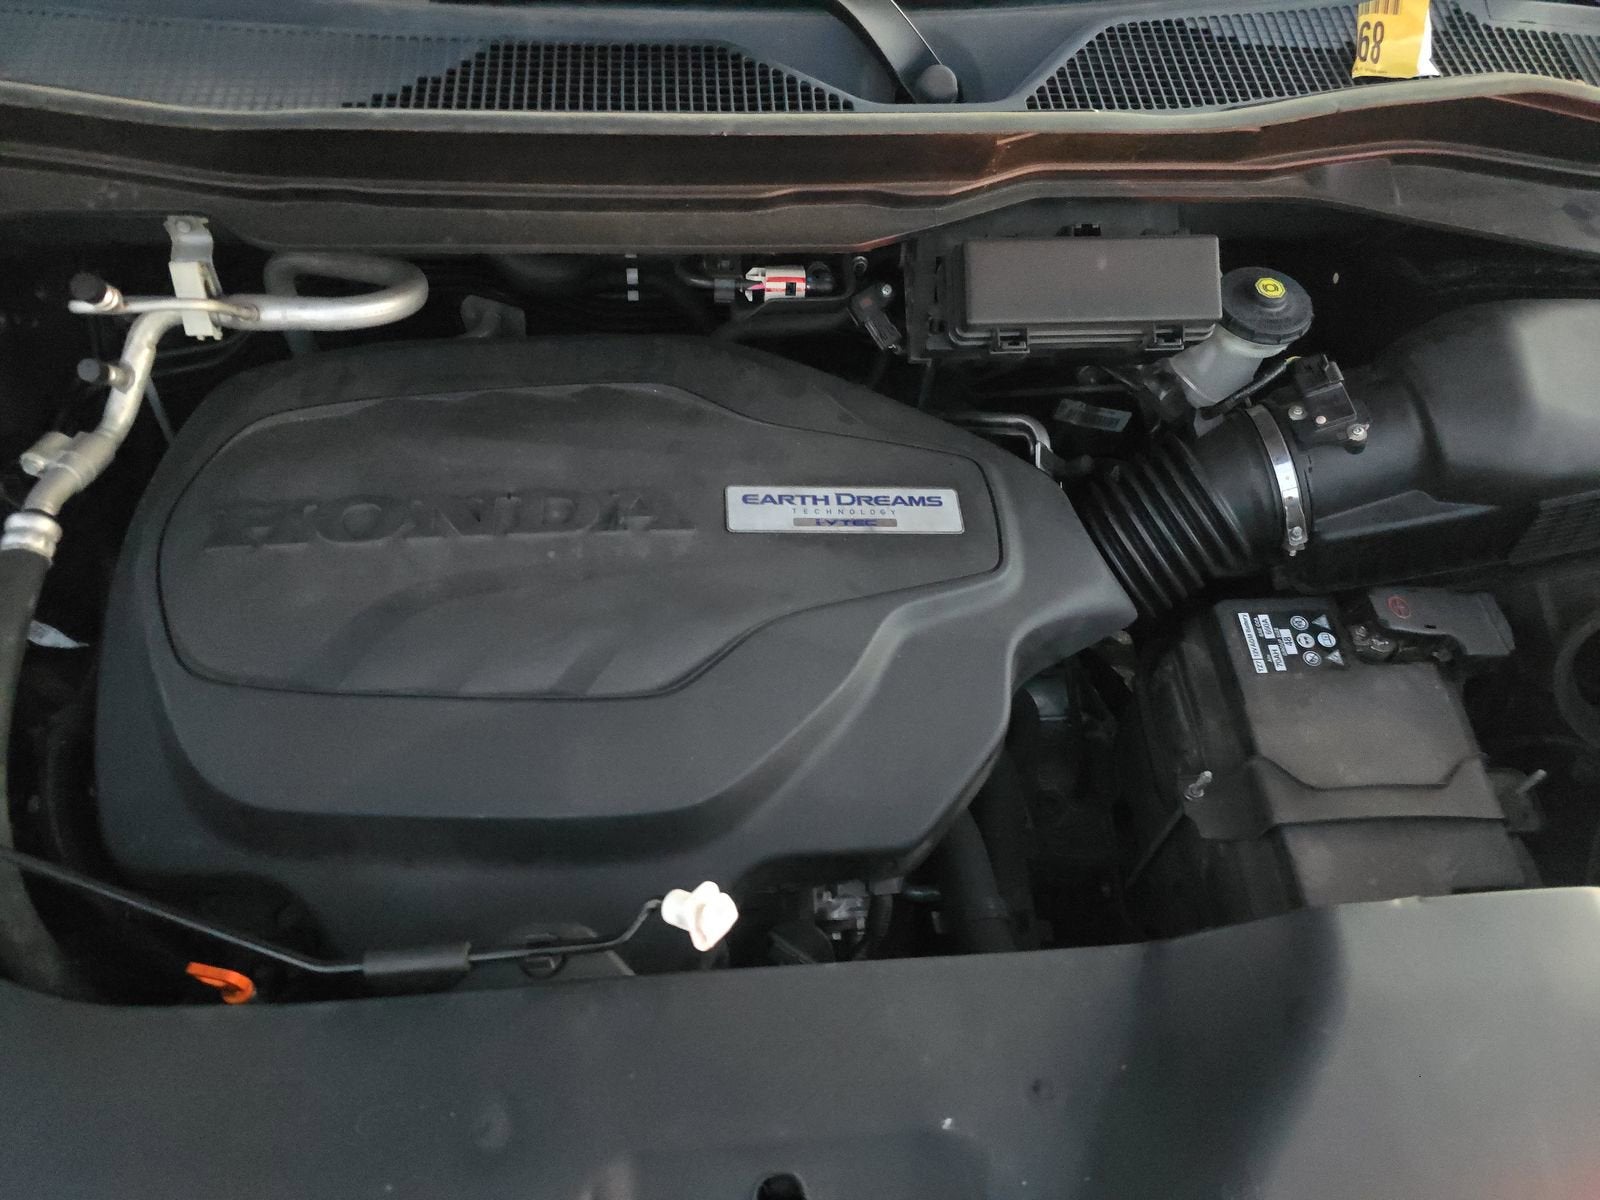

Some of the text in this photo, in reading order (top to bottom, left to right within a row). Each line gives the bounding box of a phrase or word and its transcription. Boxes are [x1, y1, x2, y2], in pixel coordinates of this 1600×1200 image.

[1358, 21, 1385, 64] 68
[741, 493, 830, 506] EARTH
[792, 508, 897, 516] TECHNOLOGY
[1284, 636, 1293, 646] 48
